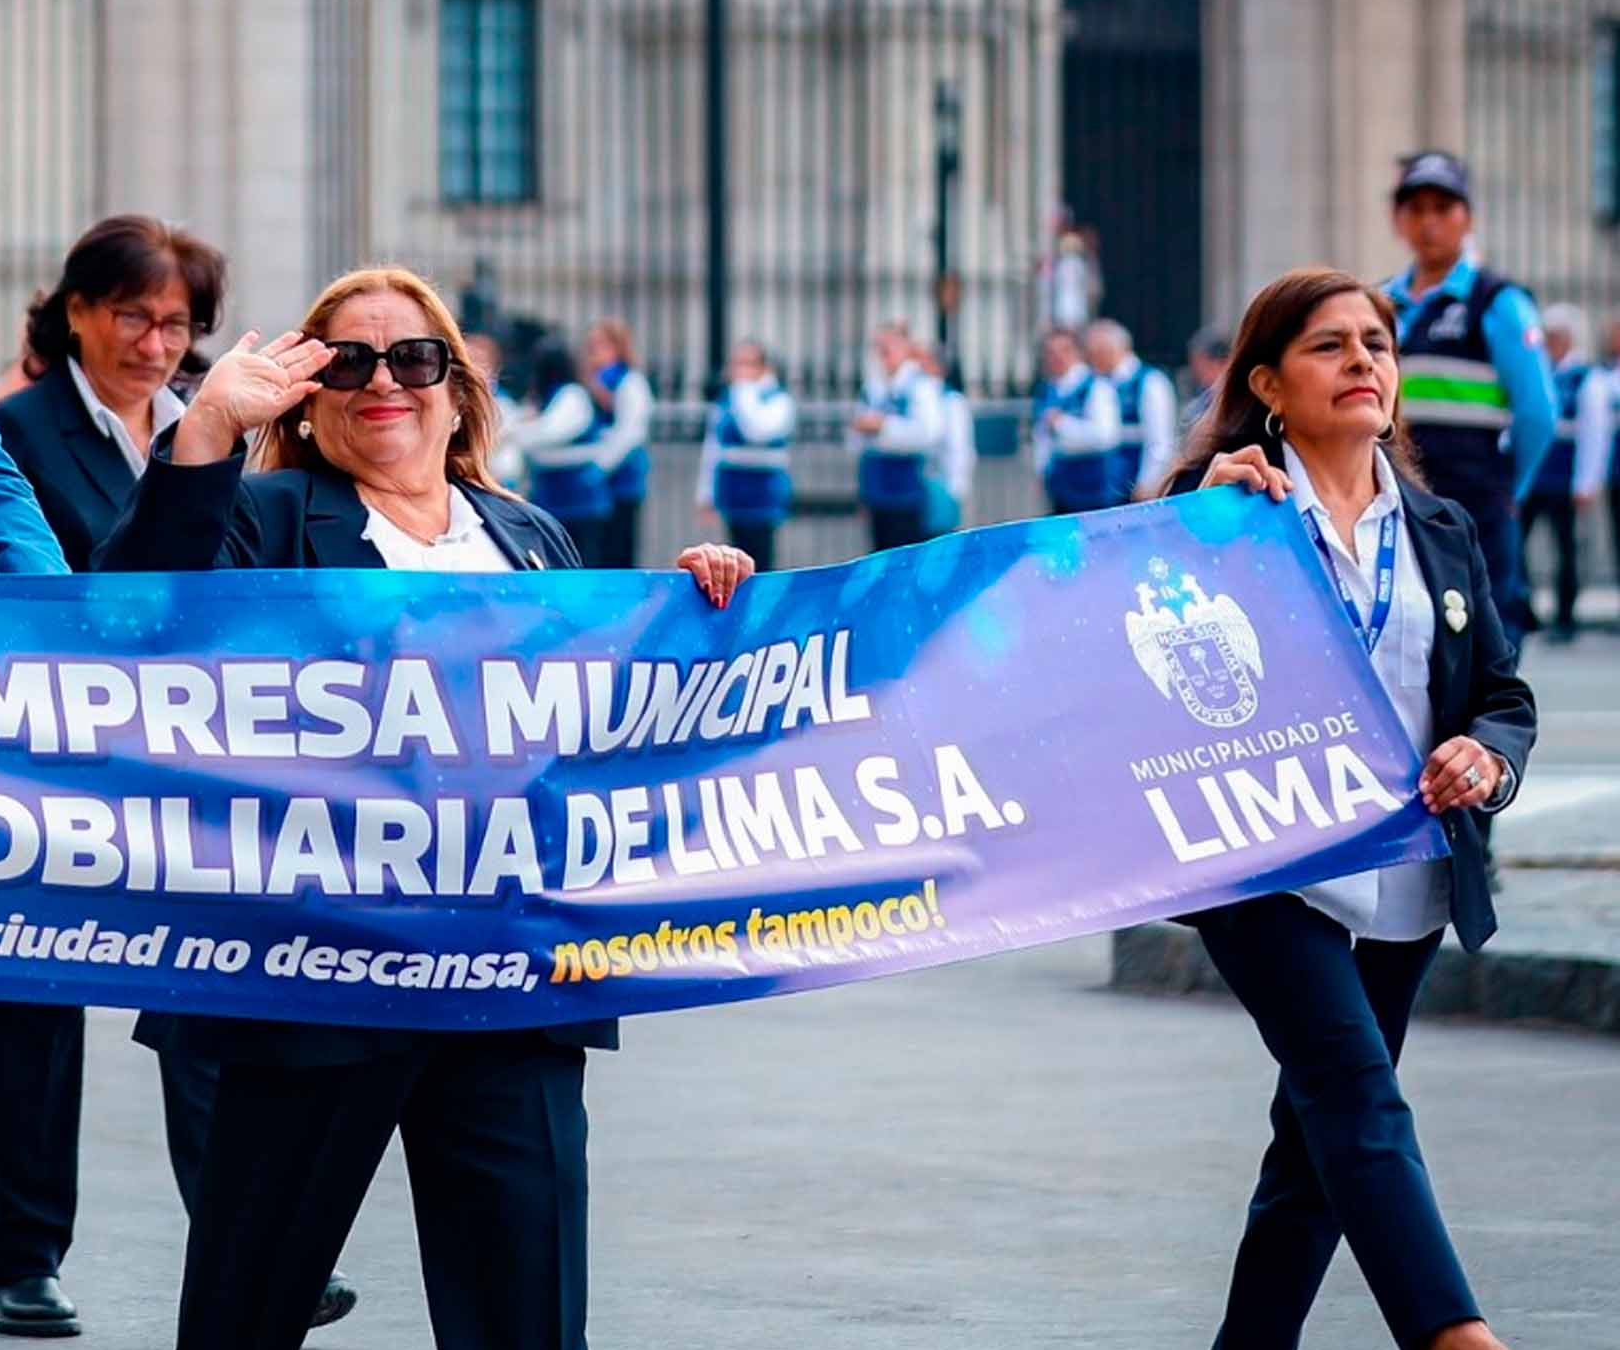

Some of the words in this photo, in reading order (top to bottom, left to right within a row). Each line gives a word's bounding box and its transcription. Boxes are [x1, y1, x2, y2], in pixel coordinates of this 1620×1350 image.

[481, 629, 871, 757] MUNICIPAL
[1130, 720, 1320, 783] MUNICIPALIDAD
[1324, 712, 1360, 738] DE
[562, 786, 659, 892] DE
[663, 766, 864, 876] LIMA
[857, 744, 1025, 847] S.A.
[1143, 743, 1405, 864] LIMA
[174, 933, 251, 974] no
[264, 935, 540, 994] descansa,
[550, 918, 736, 984] nosotros
[746, 880, 943, 957] tampoco!
